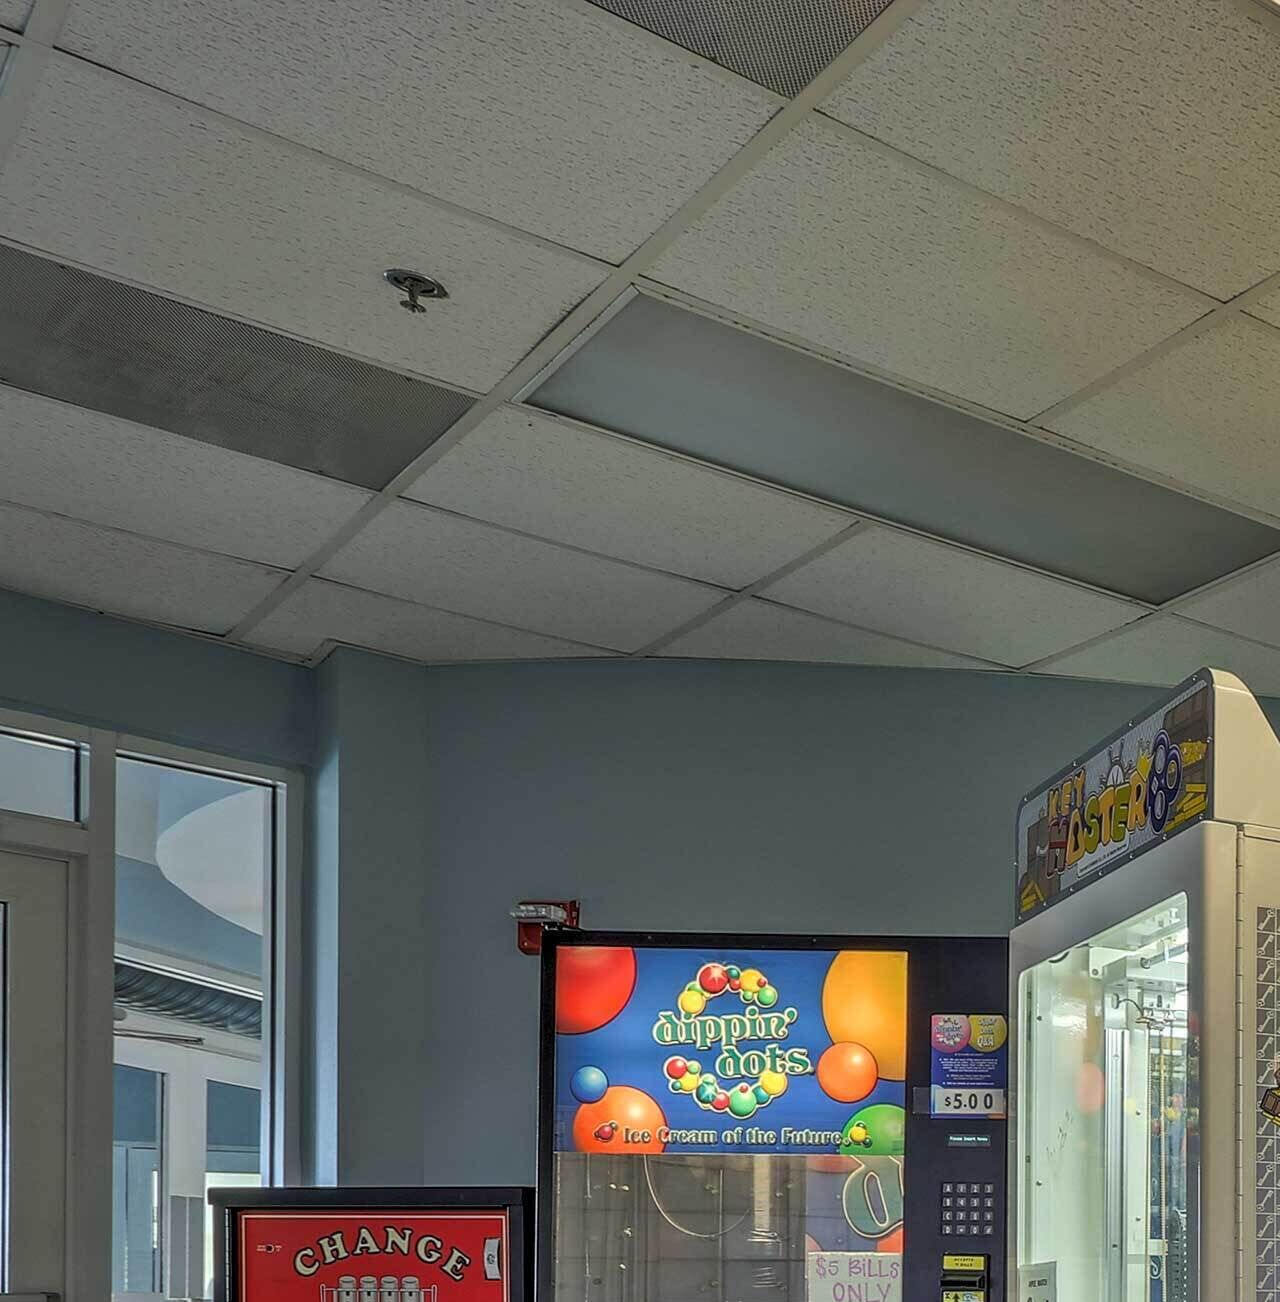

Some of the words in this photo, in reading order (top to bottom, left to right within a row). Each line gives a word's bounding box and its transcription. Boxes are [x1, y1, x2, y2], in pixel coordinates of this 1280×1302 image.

[1048, 767, 1086, 817] KEY
[1046, 769, 1149, 878] MASTER
[652, 1006, 798, 1050] dippin'
[716, 1044, 809, 1079] dots
[623, 1128, 651, 1144] Ice
[658, 1127, 717, 1145] Cream
[722, 1128, 743, 1144] of
[746, 1128, 776, 1145] the
[293, 1225, 472, 1282] CHANGE
[816, 1255, 839, 1280] $5
